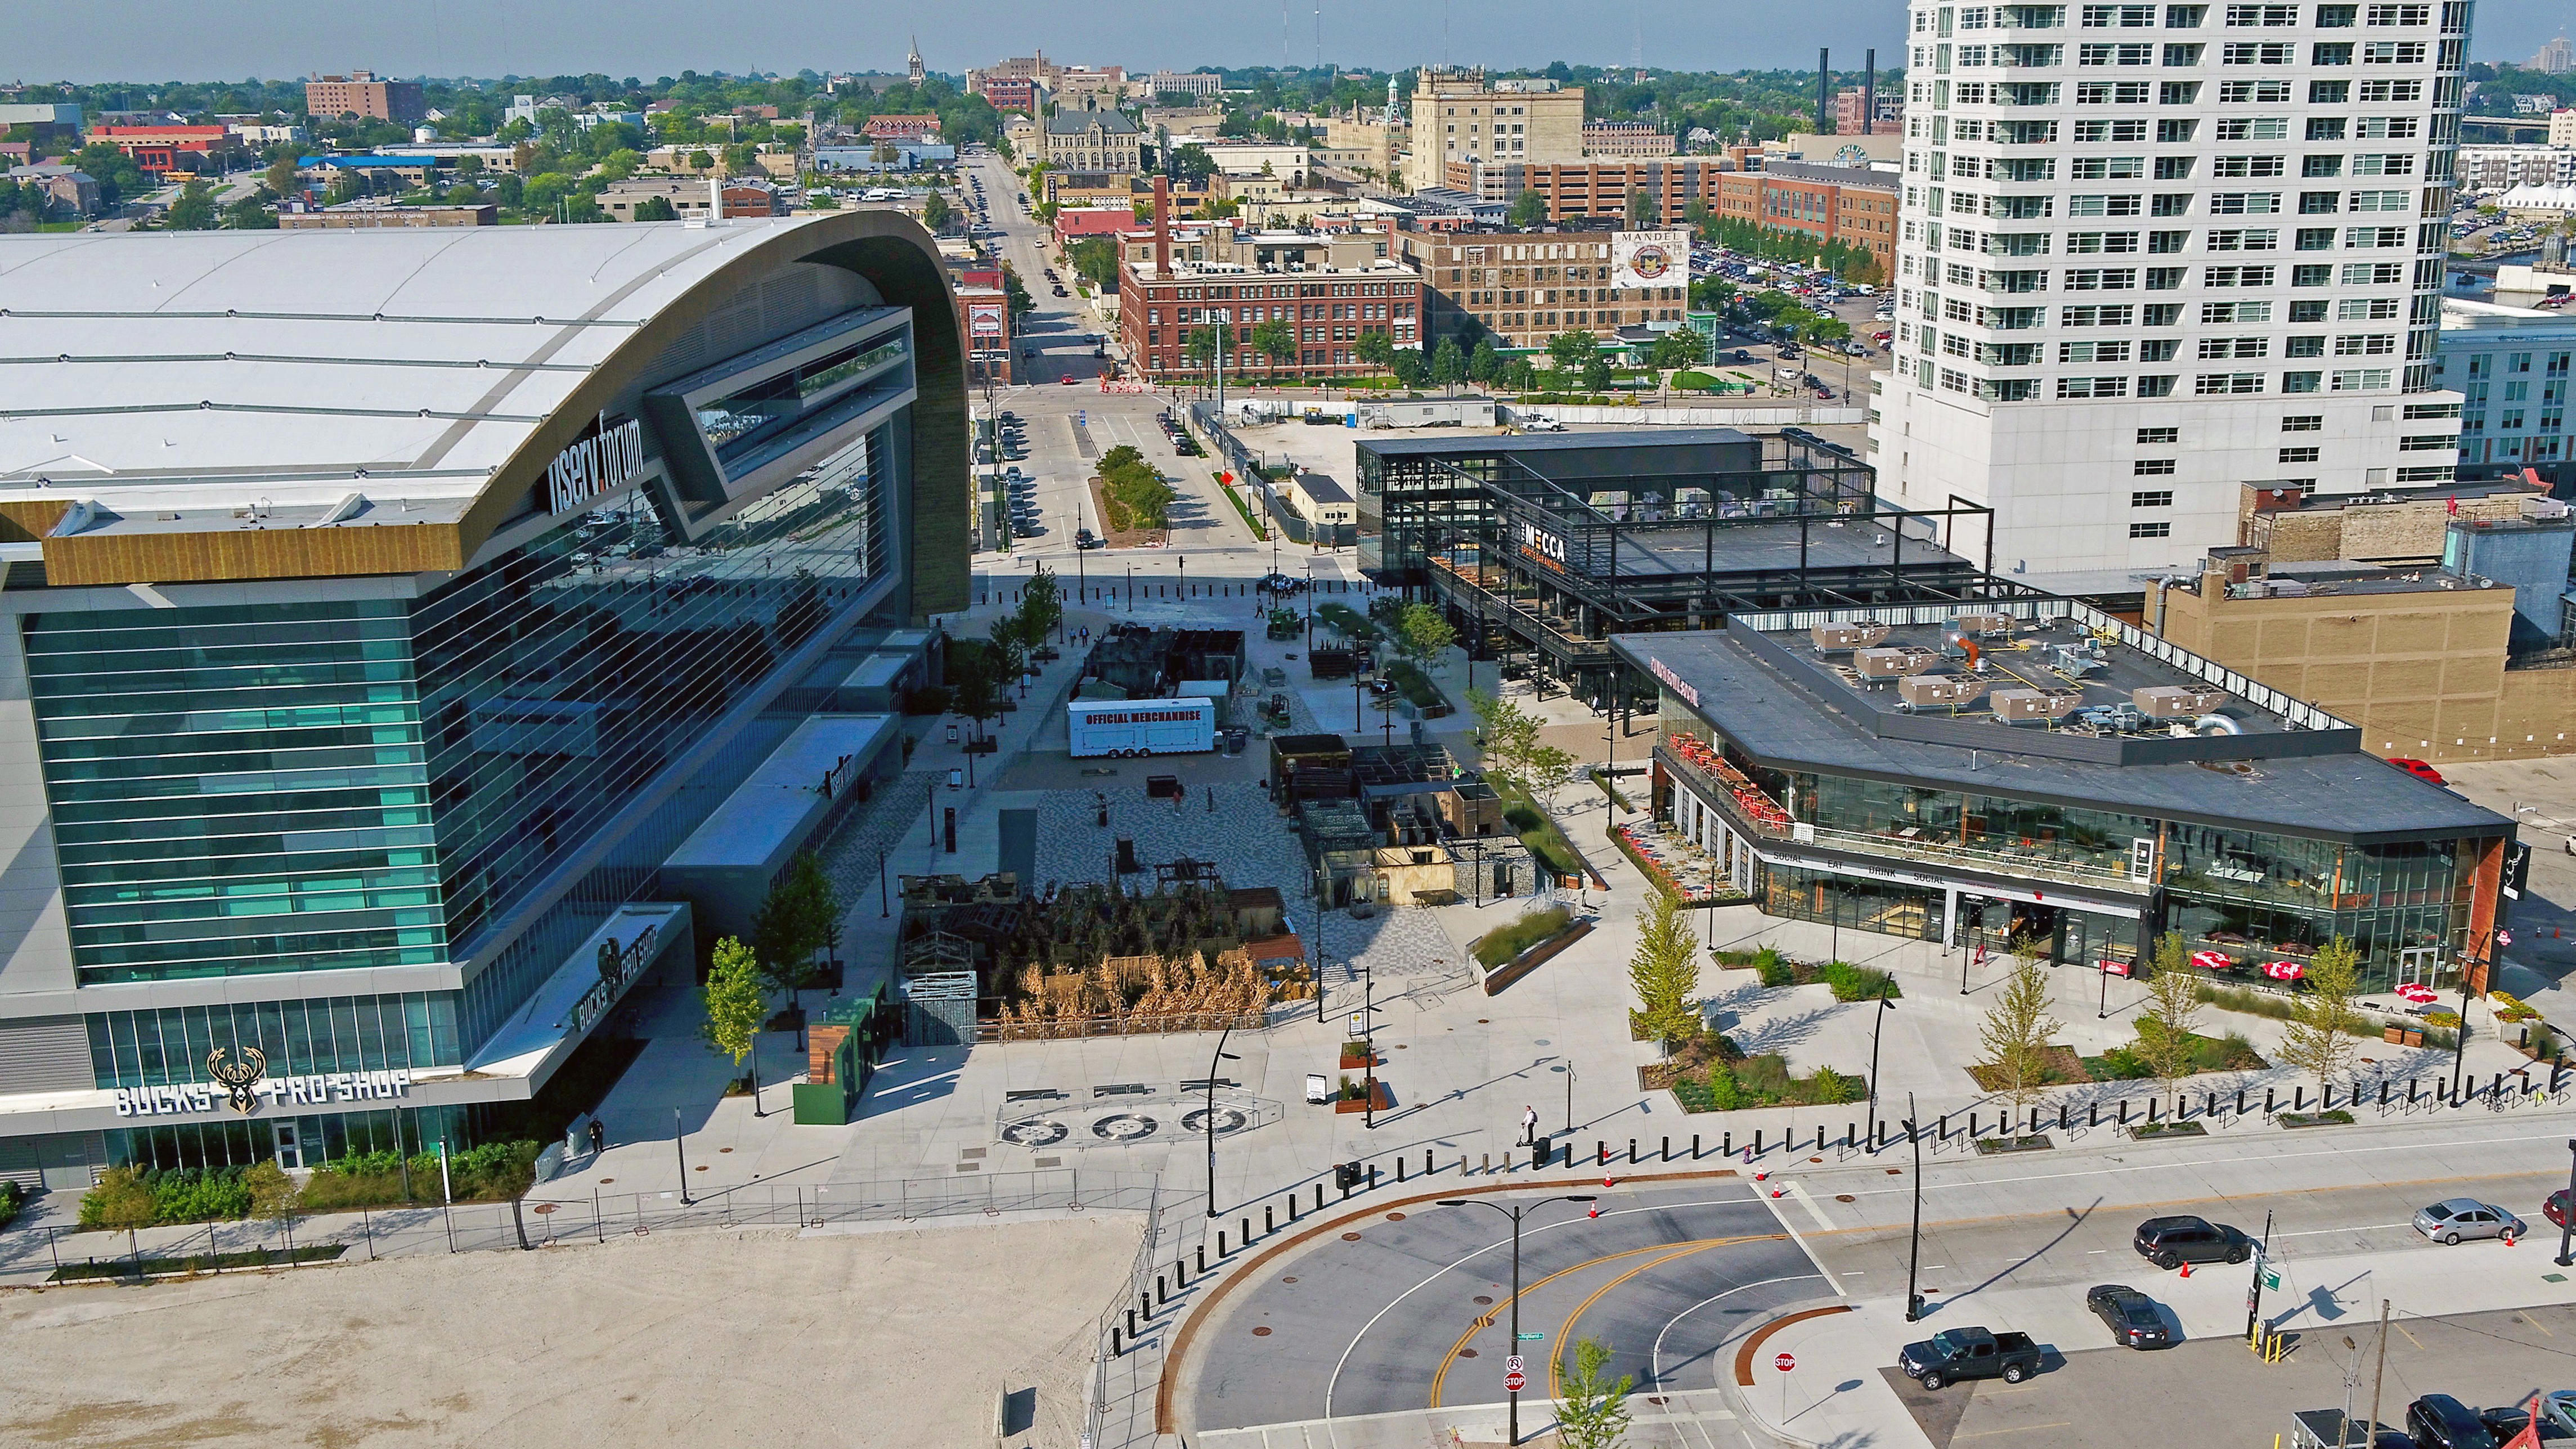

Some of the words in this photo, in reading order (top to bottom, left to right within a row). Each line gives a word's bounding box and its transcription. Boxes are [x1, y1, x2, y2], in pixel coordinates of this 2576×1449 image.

[1834, 145, 1866, 160] SCHLITZ
[1525, 523, 1565, 562] MECCA
[1536, 552, 1545, 564] BAR
[1086, 713, 1129, 725] OFFICIAL
[1132, 710, 1201, 723] MERCHANDISE
[1774, 852, 1803, 863] SOCIAL
[1827, 860, 1844, 870] EAT
[1869, 866, 1896, 878] DRINK
[1914, 872, 1945, 885] SOCIAL
[578, 980, 607, 1032] BUCKS
[621, 948, 638, 985] PRO
[638, 928, 658, 967] SHOP
[115, 1082, 212, 1116] BUCKS
[271, 1074, 327, 1105] PRO
[336, 1069, 410, 1100] SHOP
[1775, 1358, 1796, 1367] STOP
[1505, 1377, 1524, 1386] STOP
